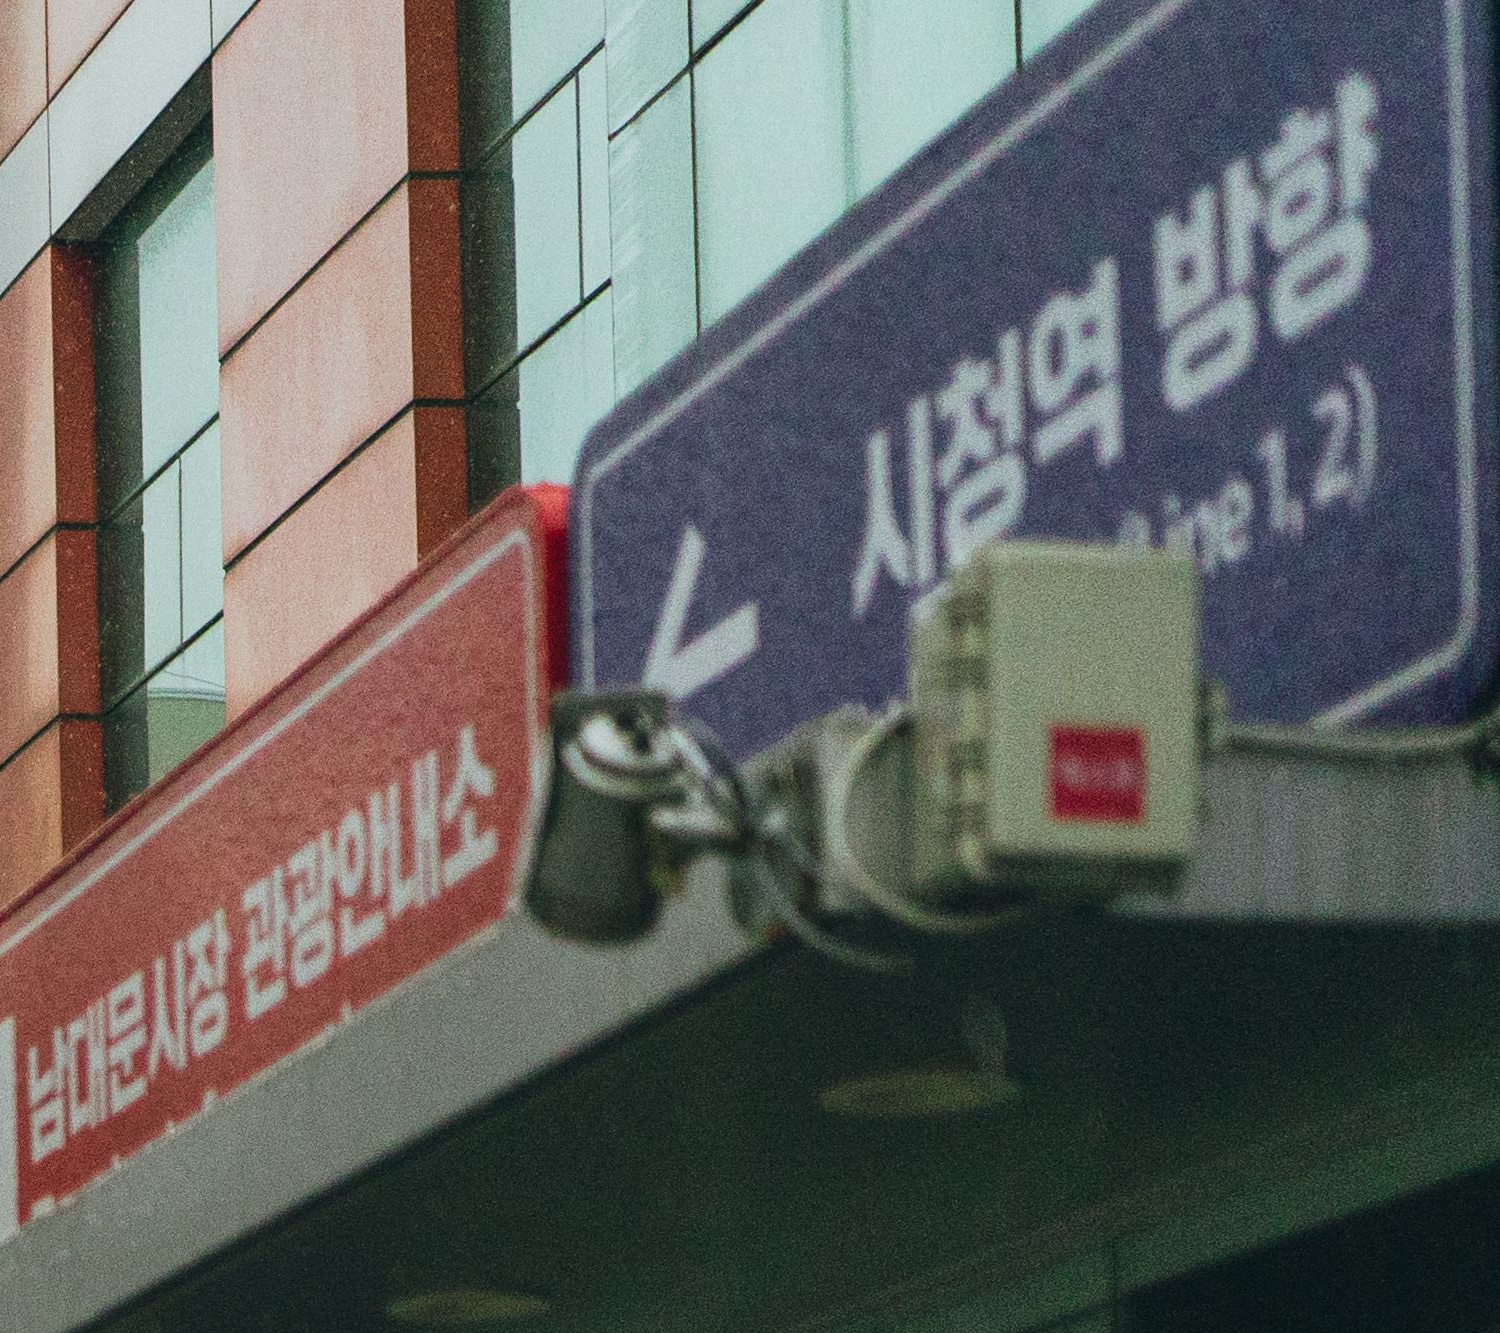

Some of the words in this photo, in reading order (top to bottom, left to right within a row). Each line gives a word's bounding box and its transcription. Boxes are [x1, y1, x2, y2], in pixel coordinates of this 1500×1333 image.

[852, 256, 1123, 616] 시청역
[1152, 70, 1380, 413] 방향
[26, 906, 231, 1160] 남대문시장
[240, 724, 500, 1023] 관광안내소
